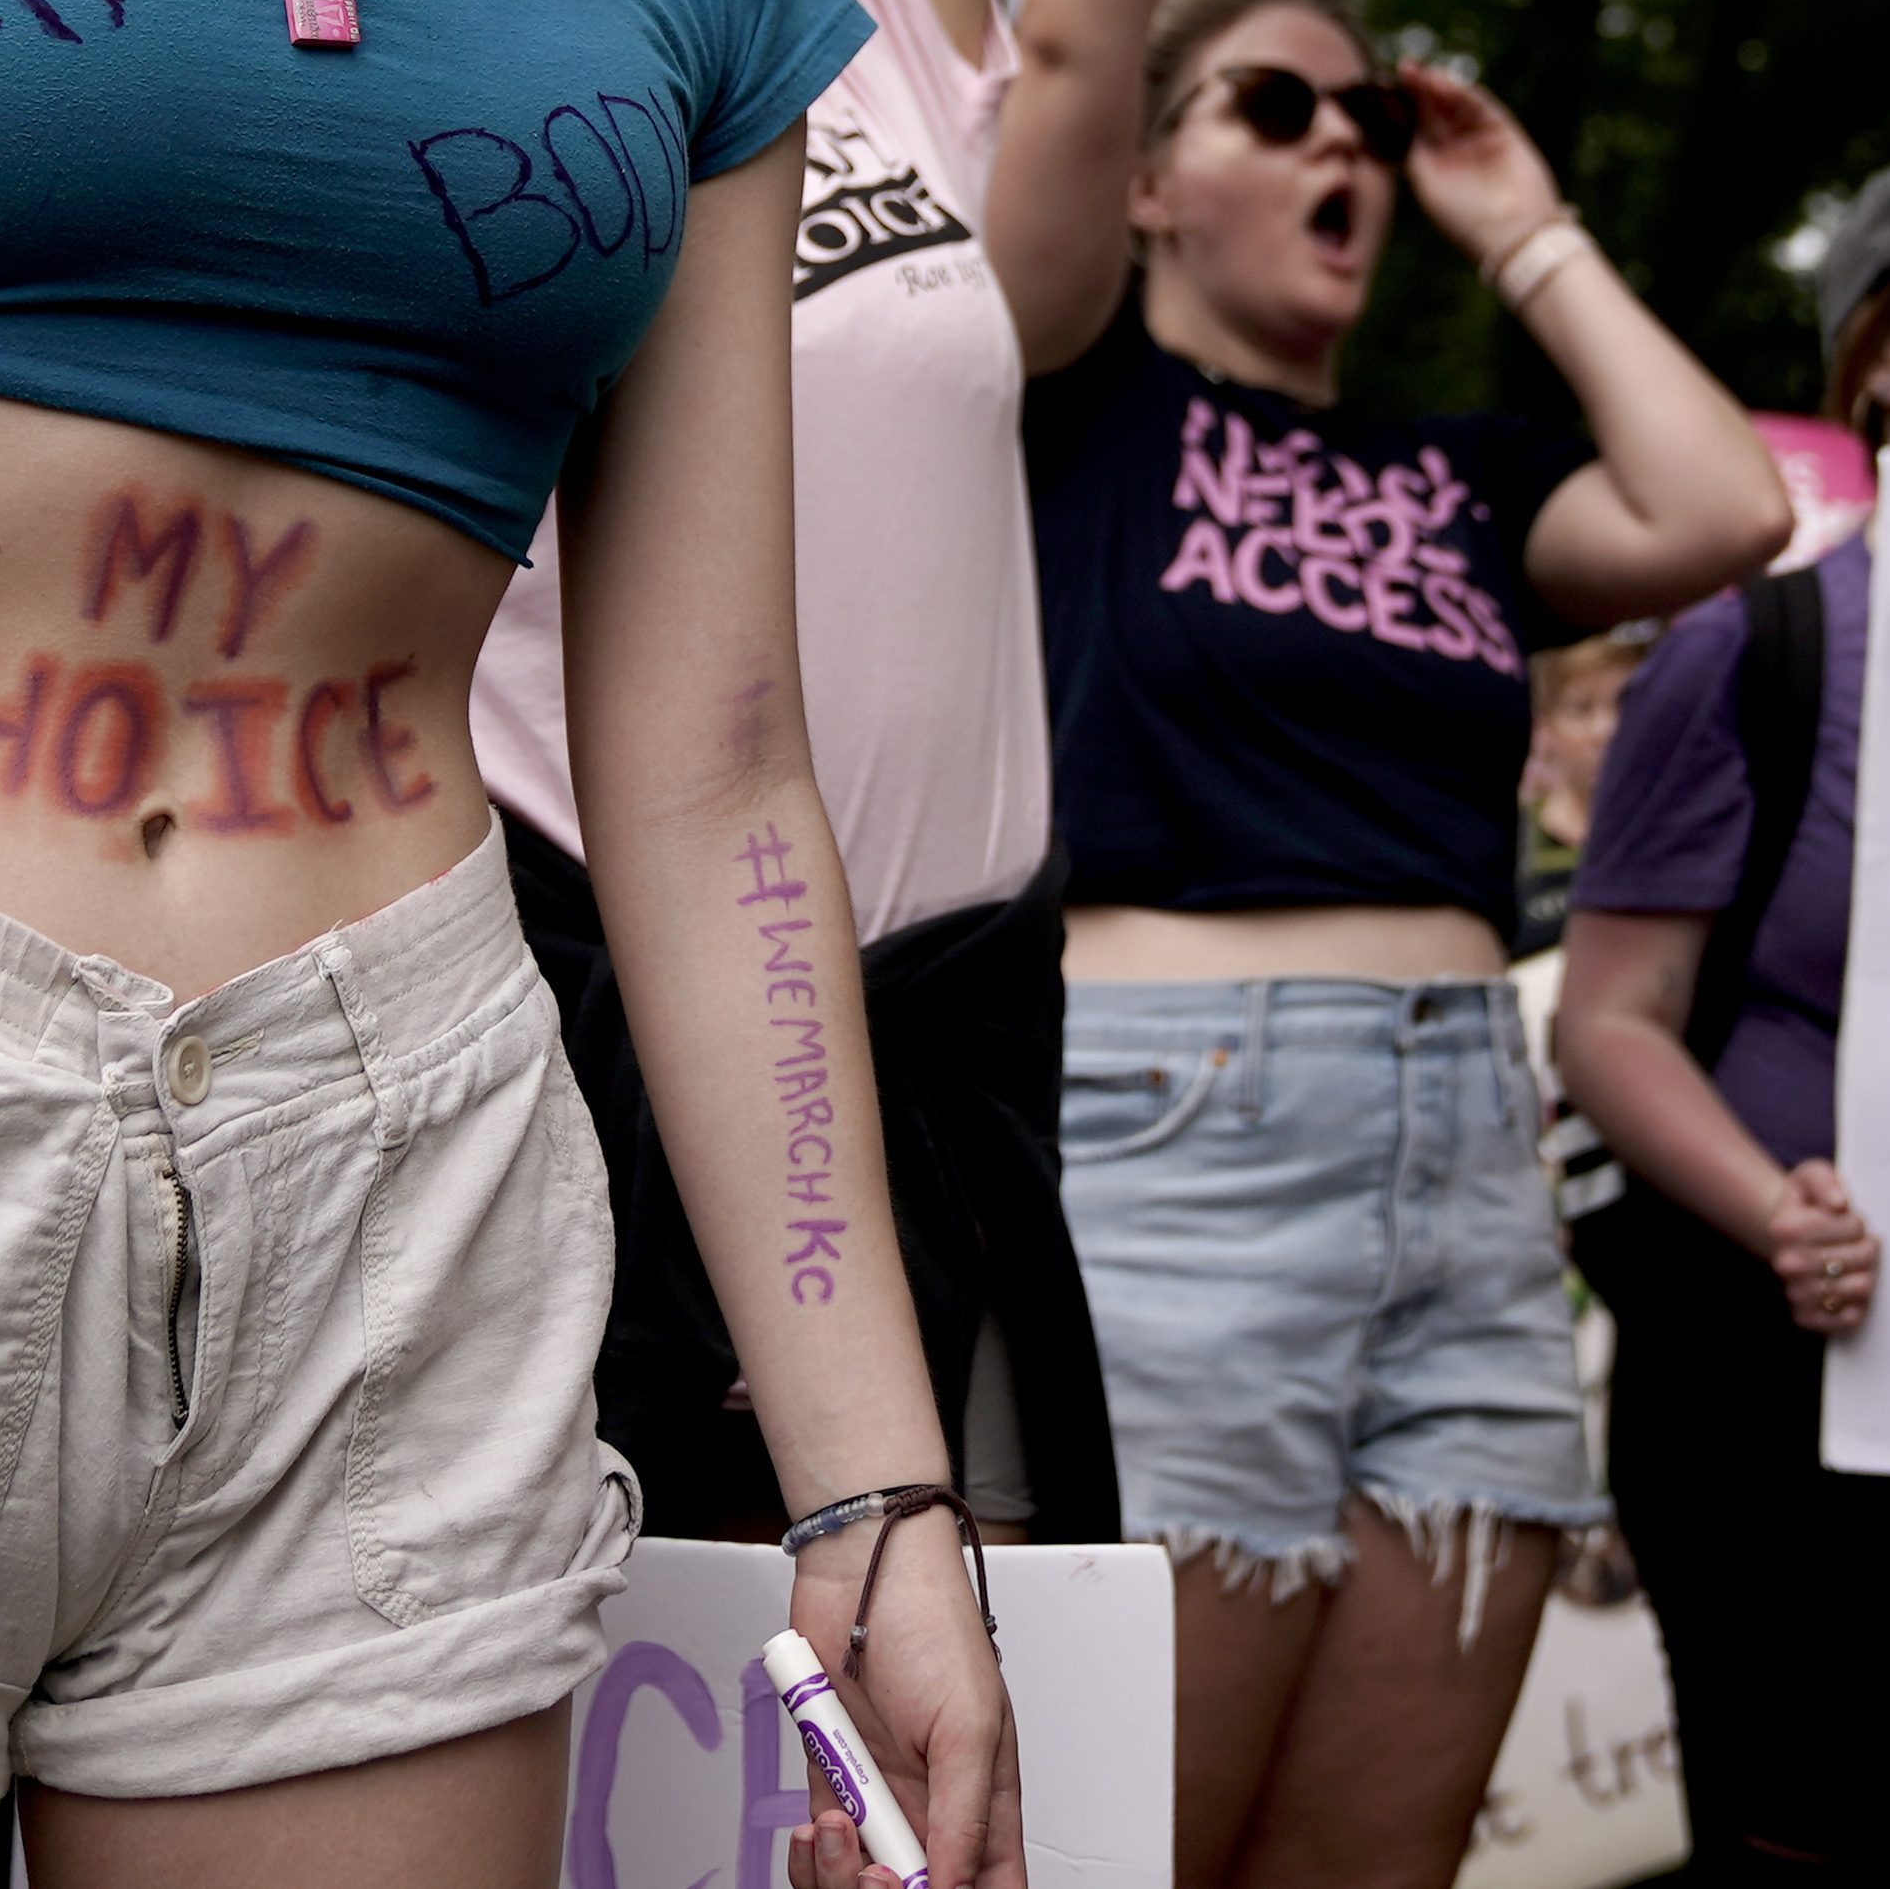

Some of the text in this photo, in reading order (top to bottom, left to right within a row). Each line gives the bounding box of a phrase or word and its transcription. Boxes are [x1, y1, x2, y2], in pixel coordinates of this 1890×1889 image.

[895, 262, 952, 297] Roe
[79, 479, 320, 658] MY
[1158, 517, 1527, 682] ACCESS
[731, 821, 847, 1305] #WEMARCHKC
